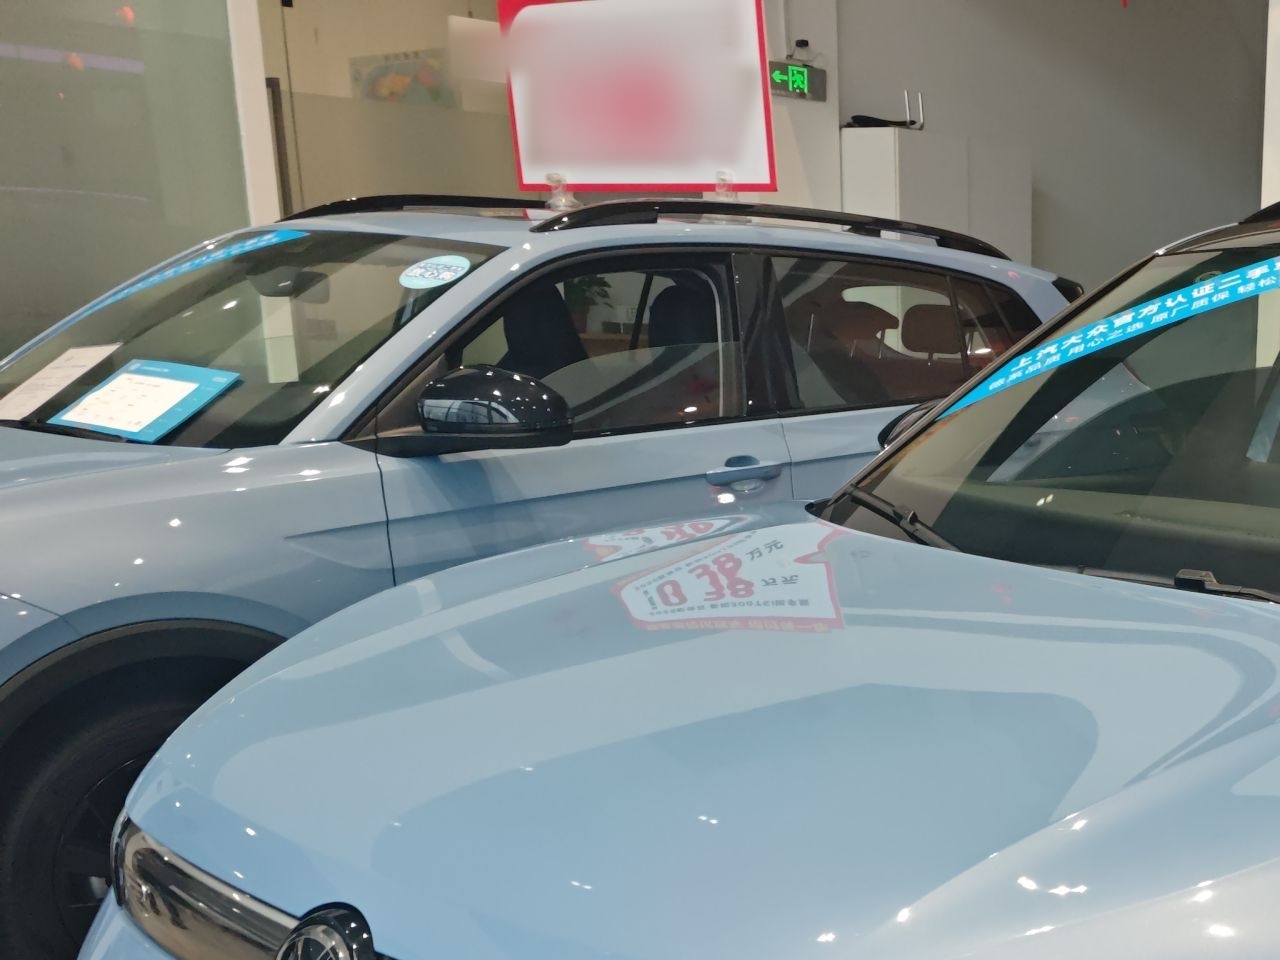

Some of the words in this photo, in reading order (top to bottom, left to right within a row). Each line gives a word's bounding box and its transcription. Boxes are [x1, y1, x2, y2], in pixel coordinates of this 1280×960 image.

[1067, 321, 1144, 358] 用心之选
[1150, 290, 1230, 325] 原厂质保
